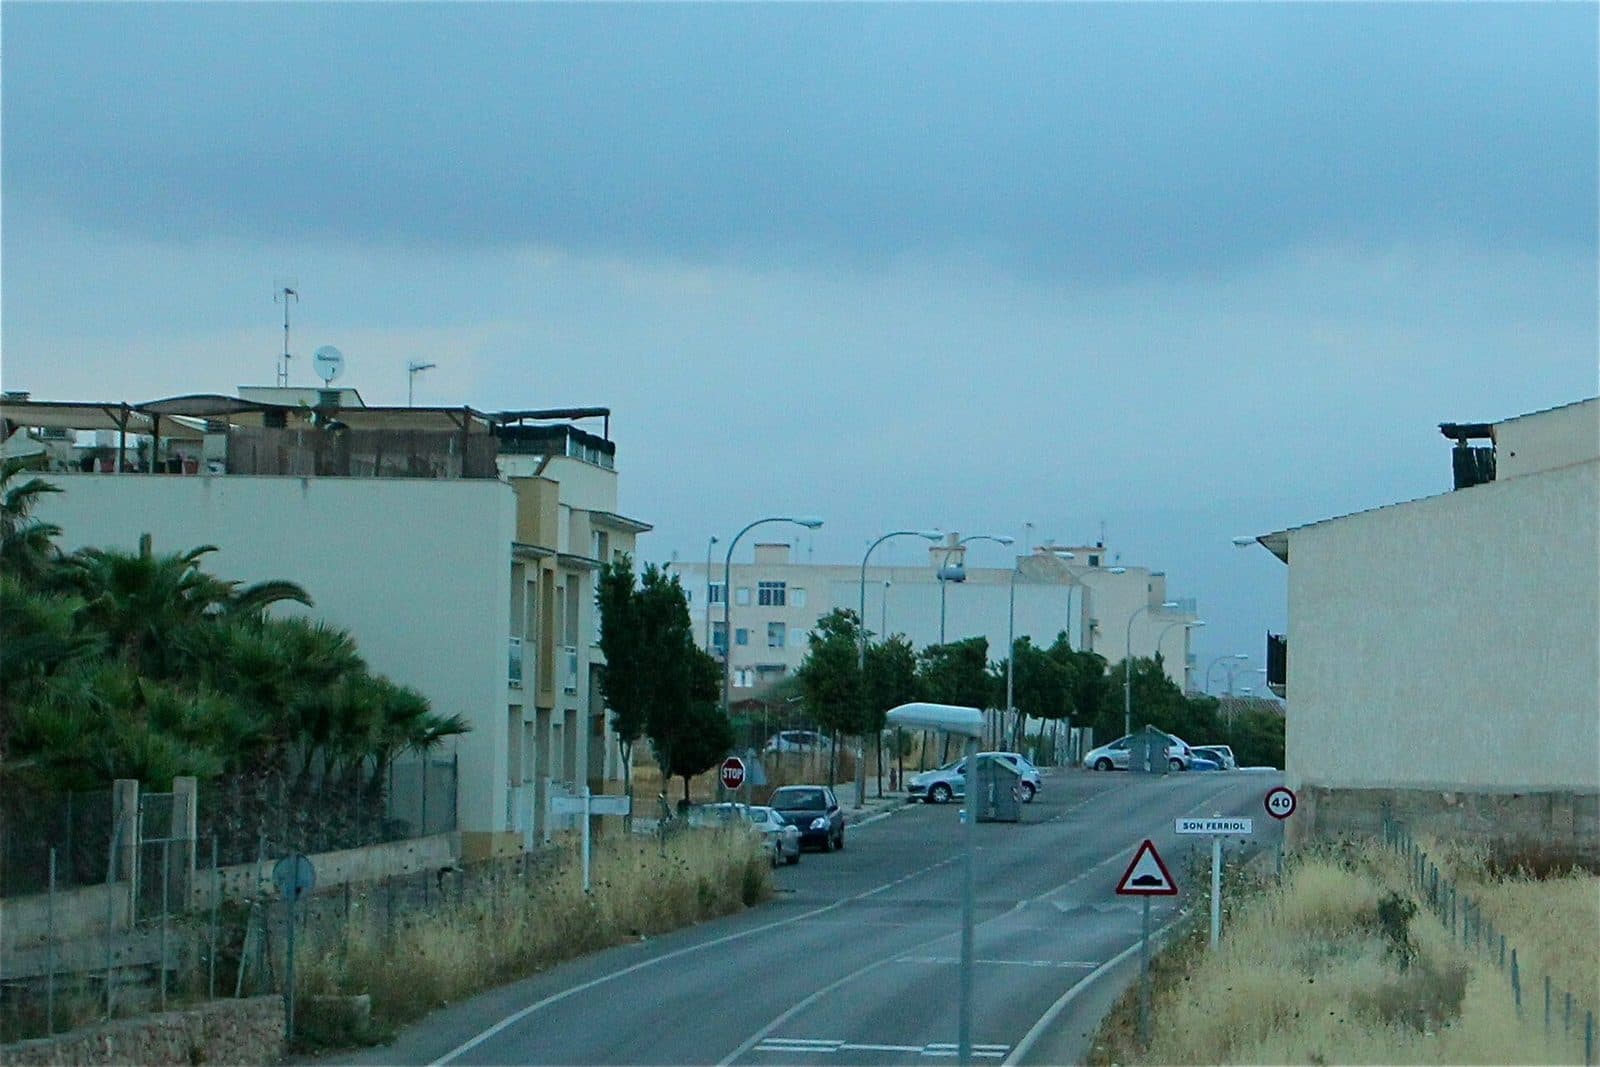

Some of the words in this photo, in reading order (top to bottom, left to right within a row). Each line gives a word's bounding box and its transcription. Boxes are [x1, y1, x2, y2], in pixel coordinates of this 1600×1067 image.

[723, 767, 742, 779] STOP
[1271, 798, 1290, 808] 40
[1183, 822, 1203, 830] SON
[1206, 822, 1245, 830] FERRIOL
